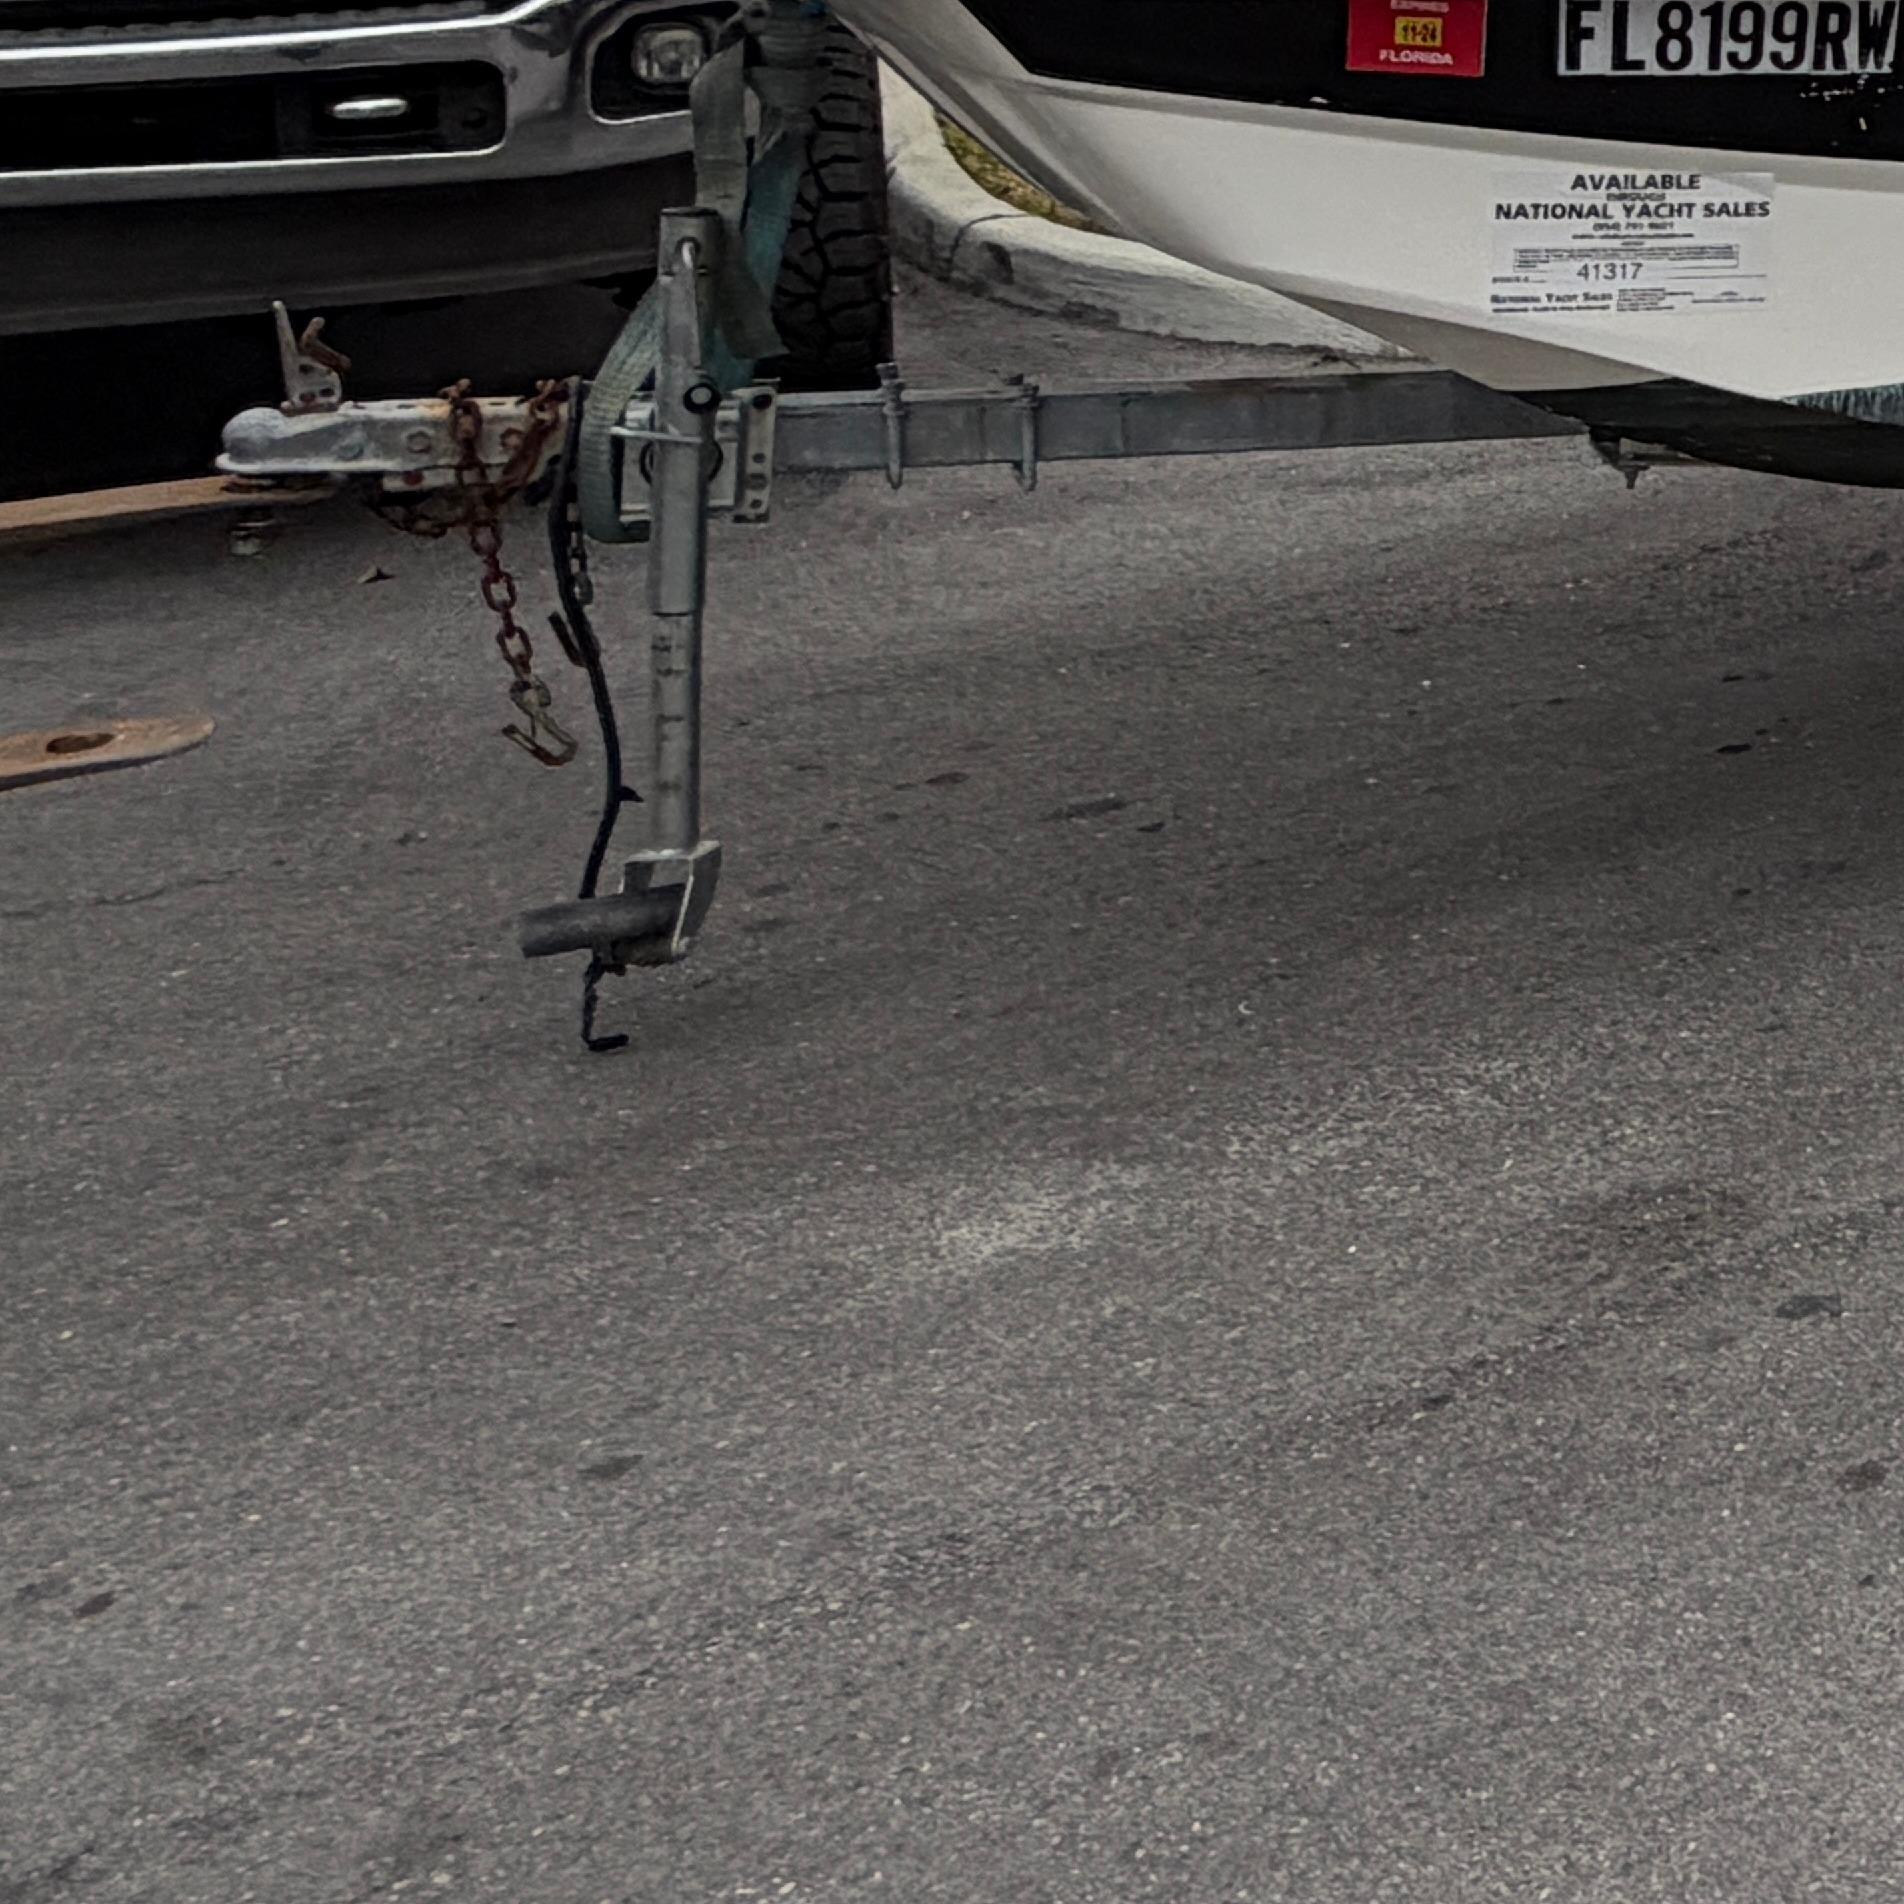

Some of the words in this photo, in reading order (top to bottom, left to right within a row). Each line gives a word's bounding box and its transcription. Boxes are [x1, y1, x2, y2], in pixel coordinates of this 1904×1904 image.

[1378, 48, 1454, 65] FLORIDA
[1571, 174, 1701, 191] AVAILABLE
[1494, 202, 1615, 220] NATIONAL
[1622, 202, 1697, 219] YACHT
[1702, 201, 1771, 218] SALES
[1577, 262, 1644, 281] 41317
